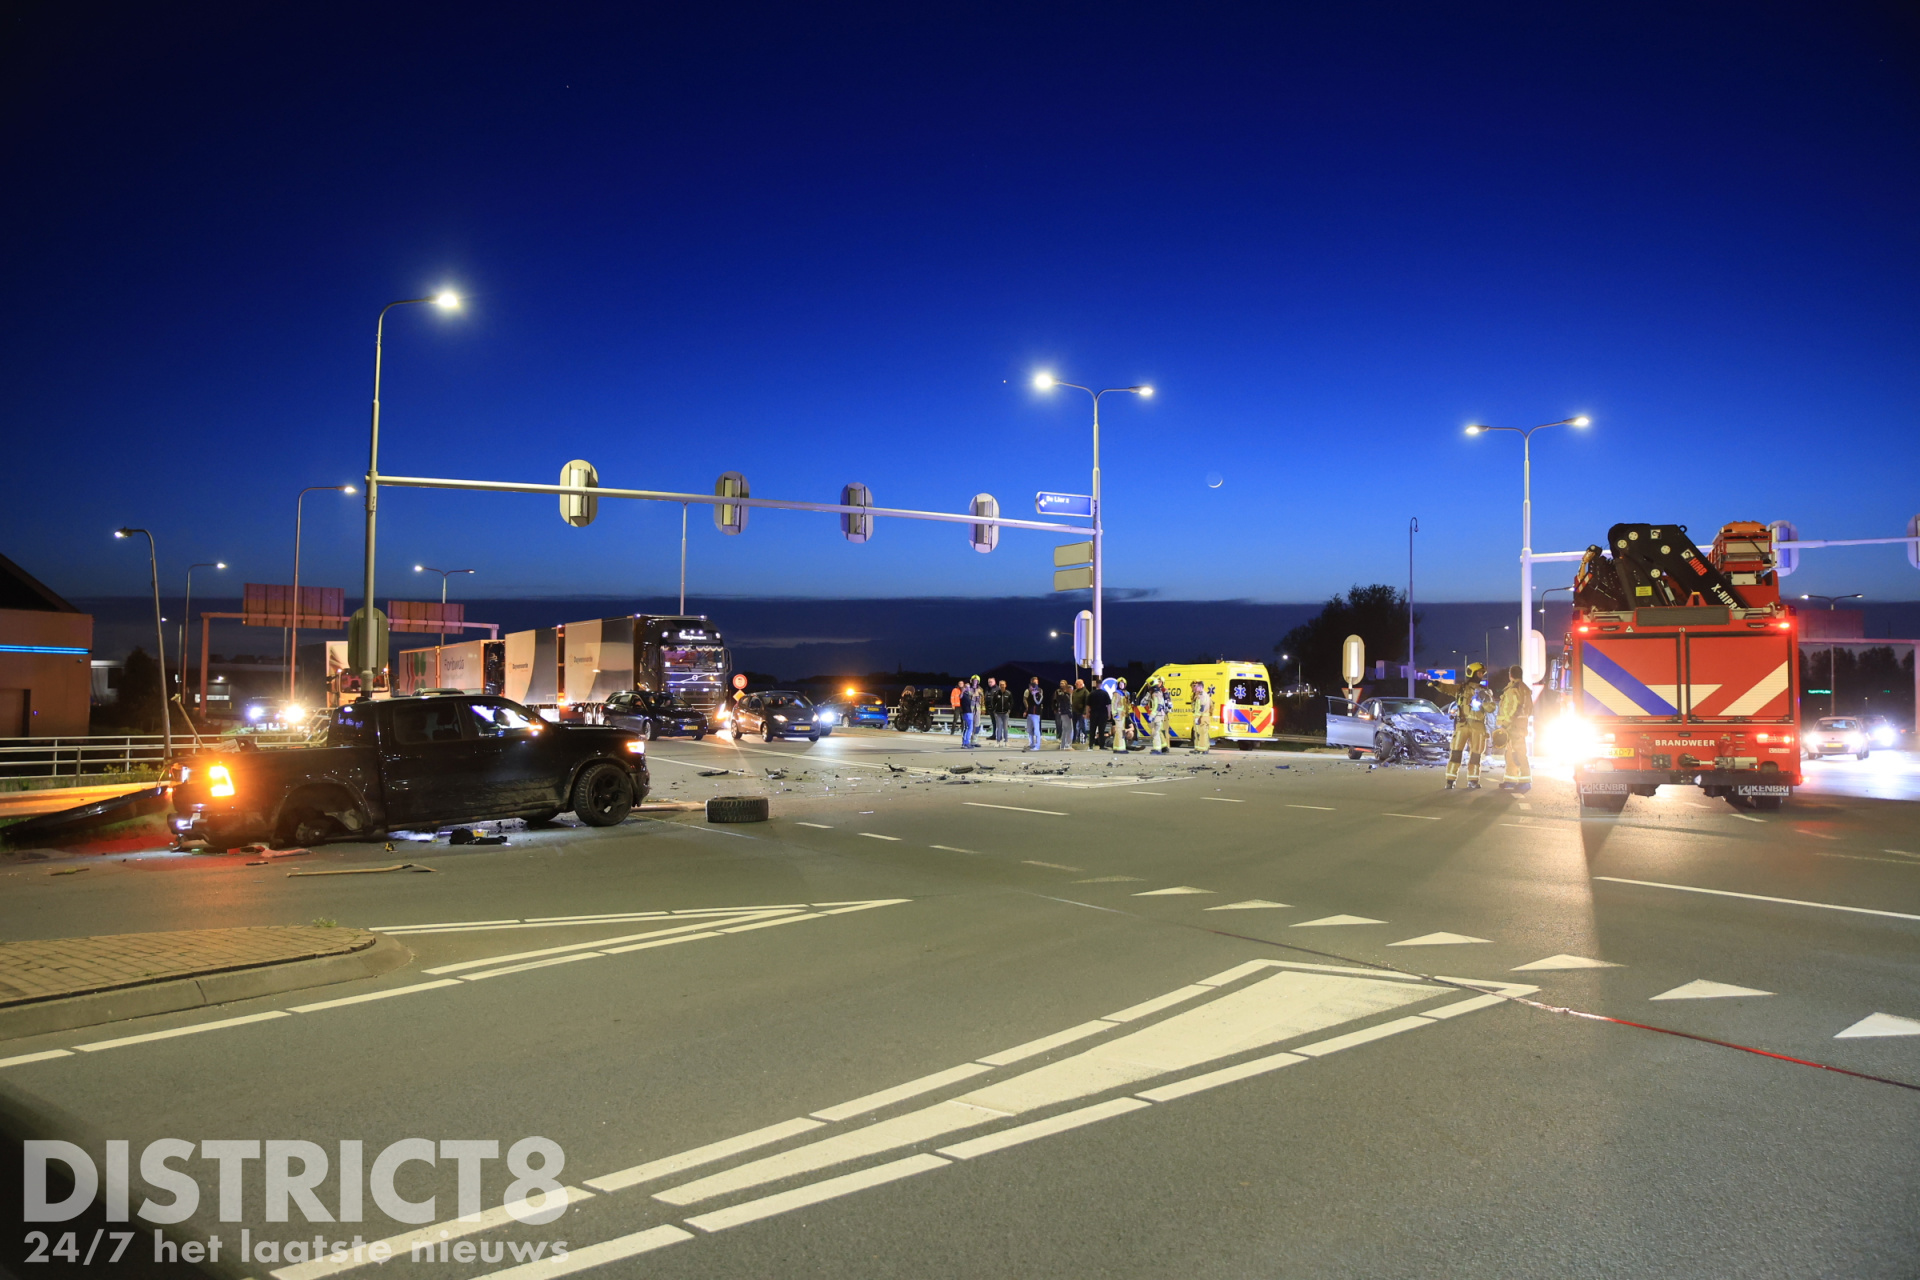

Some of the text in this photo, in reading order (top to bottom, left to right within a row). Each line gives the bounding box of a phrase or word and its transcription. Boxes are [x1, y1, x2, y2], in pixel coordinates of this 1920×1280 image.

[1689, 557, 1708, 576] HIAB
[1655, 739, 1716, 747] BRANDWEER
[1592, 783, 1628, 791] KENBRI
